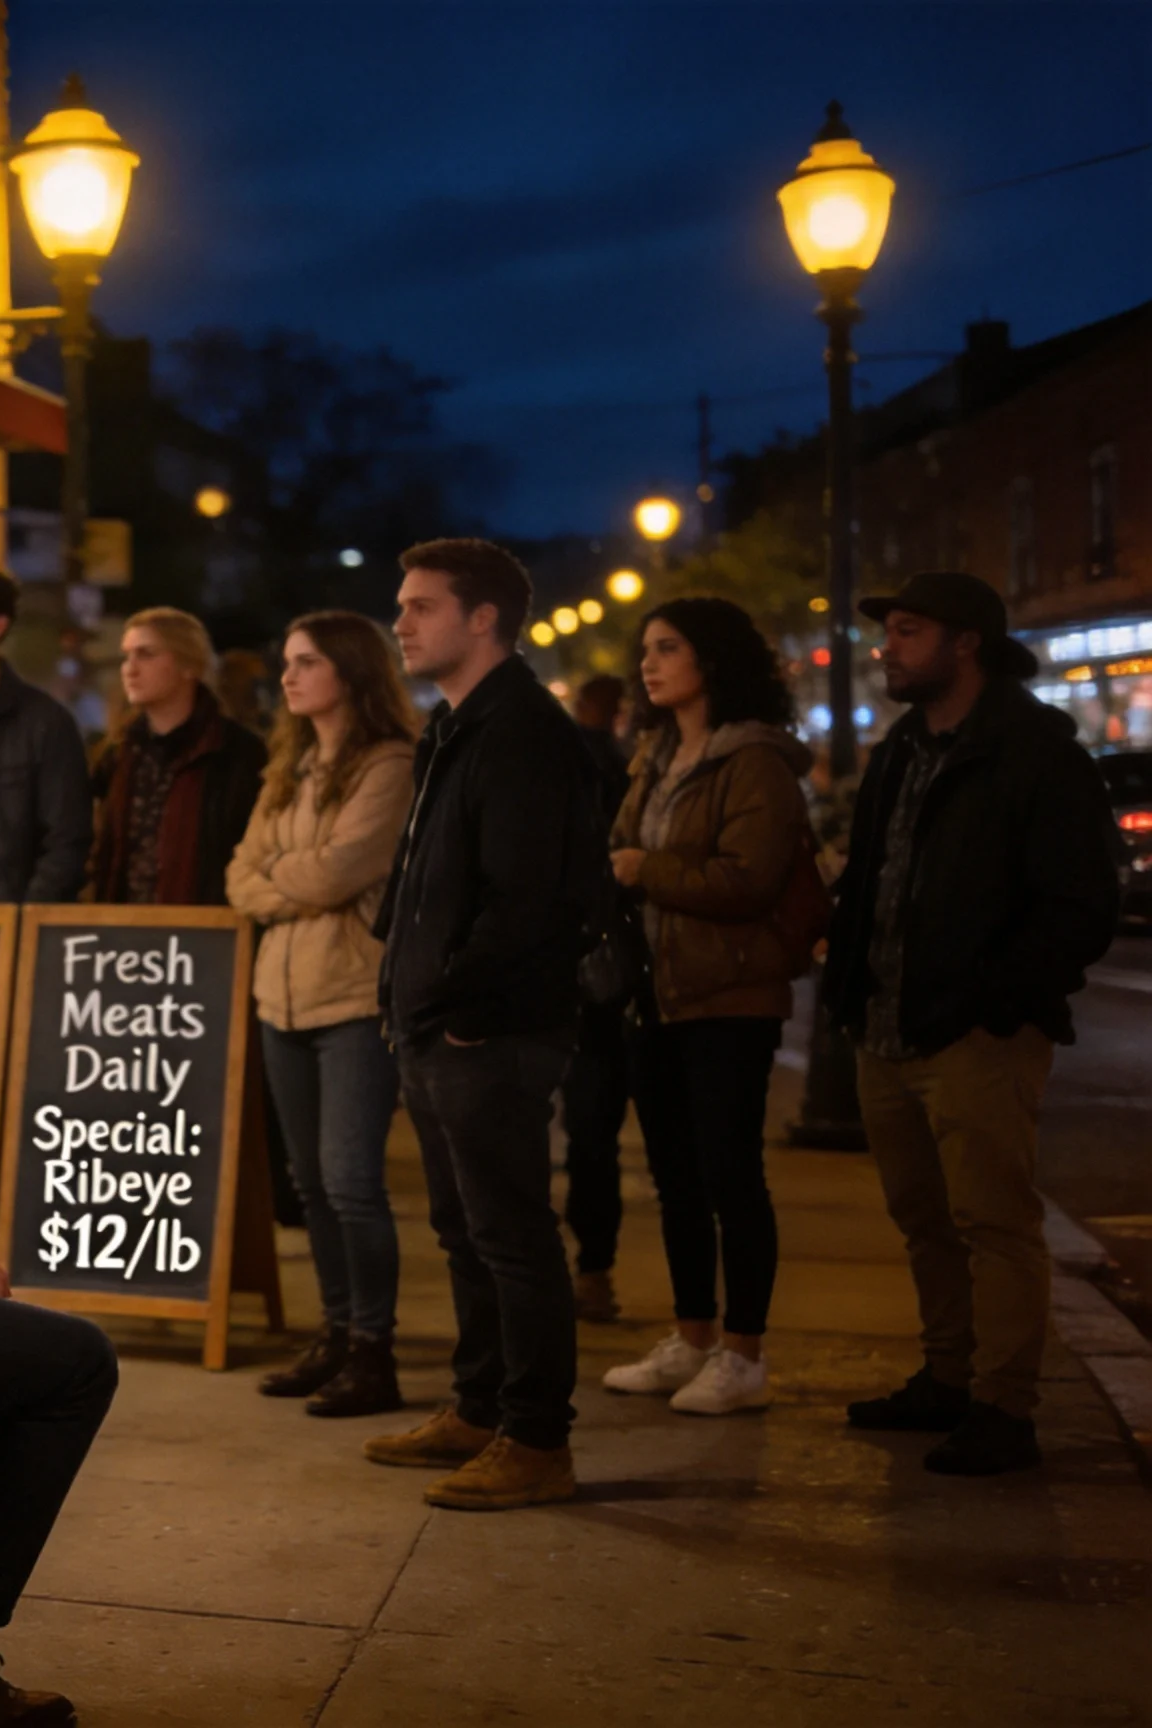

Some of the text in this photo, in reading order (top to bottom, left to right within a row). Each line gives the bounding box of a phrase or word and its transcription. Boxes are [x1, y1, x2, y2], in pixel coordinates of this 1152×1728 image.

[63, 935, 194, 985] Fresh
[61, 989, 205, 1038] Meats
[65, 1043, 191, 1107] Daily
[32, 1105, 202, 1160] Special:
[43, 1159, 192, 1216] Ribeye
[38, 1211, 201, 1280] $12/lb
